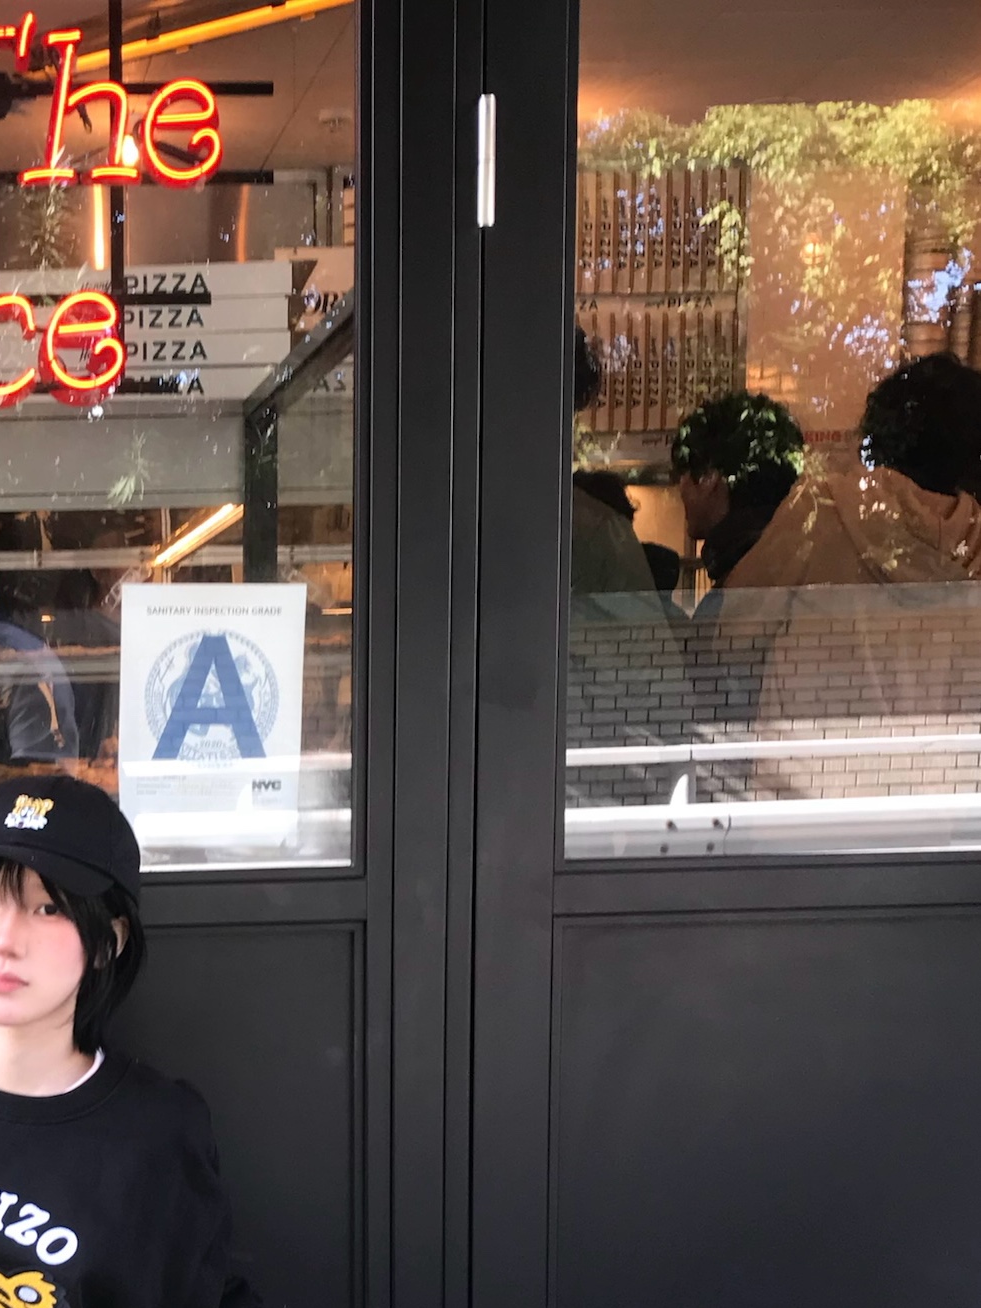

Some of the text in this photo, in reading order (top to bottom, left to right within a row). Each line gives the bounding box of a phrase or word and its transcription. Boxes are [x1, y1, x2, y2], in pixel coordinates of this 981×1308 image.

[123, 272, 210, 294] PIZZA
[123, 306, 205, 329] PIZZA
[125, 340, 208, 362] PIZZA
[146, 605, 283, 616] SANITARY INSPECTION GRADE
[151, 633, 267, 760] A
